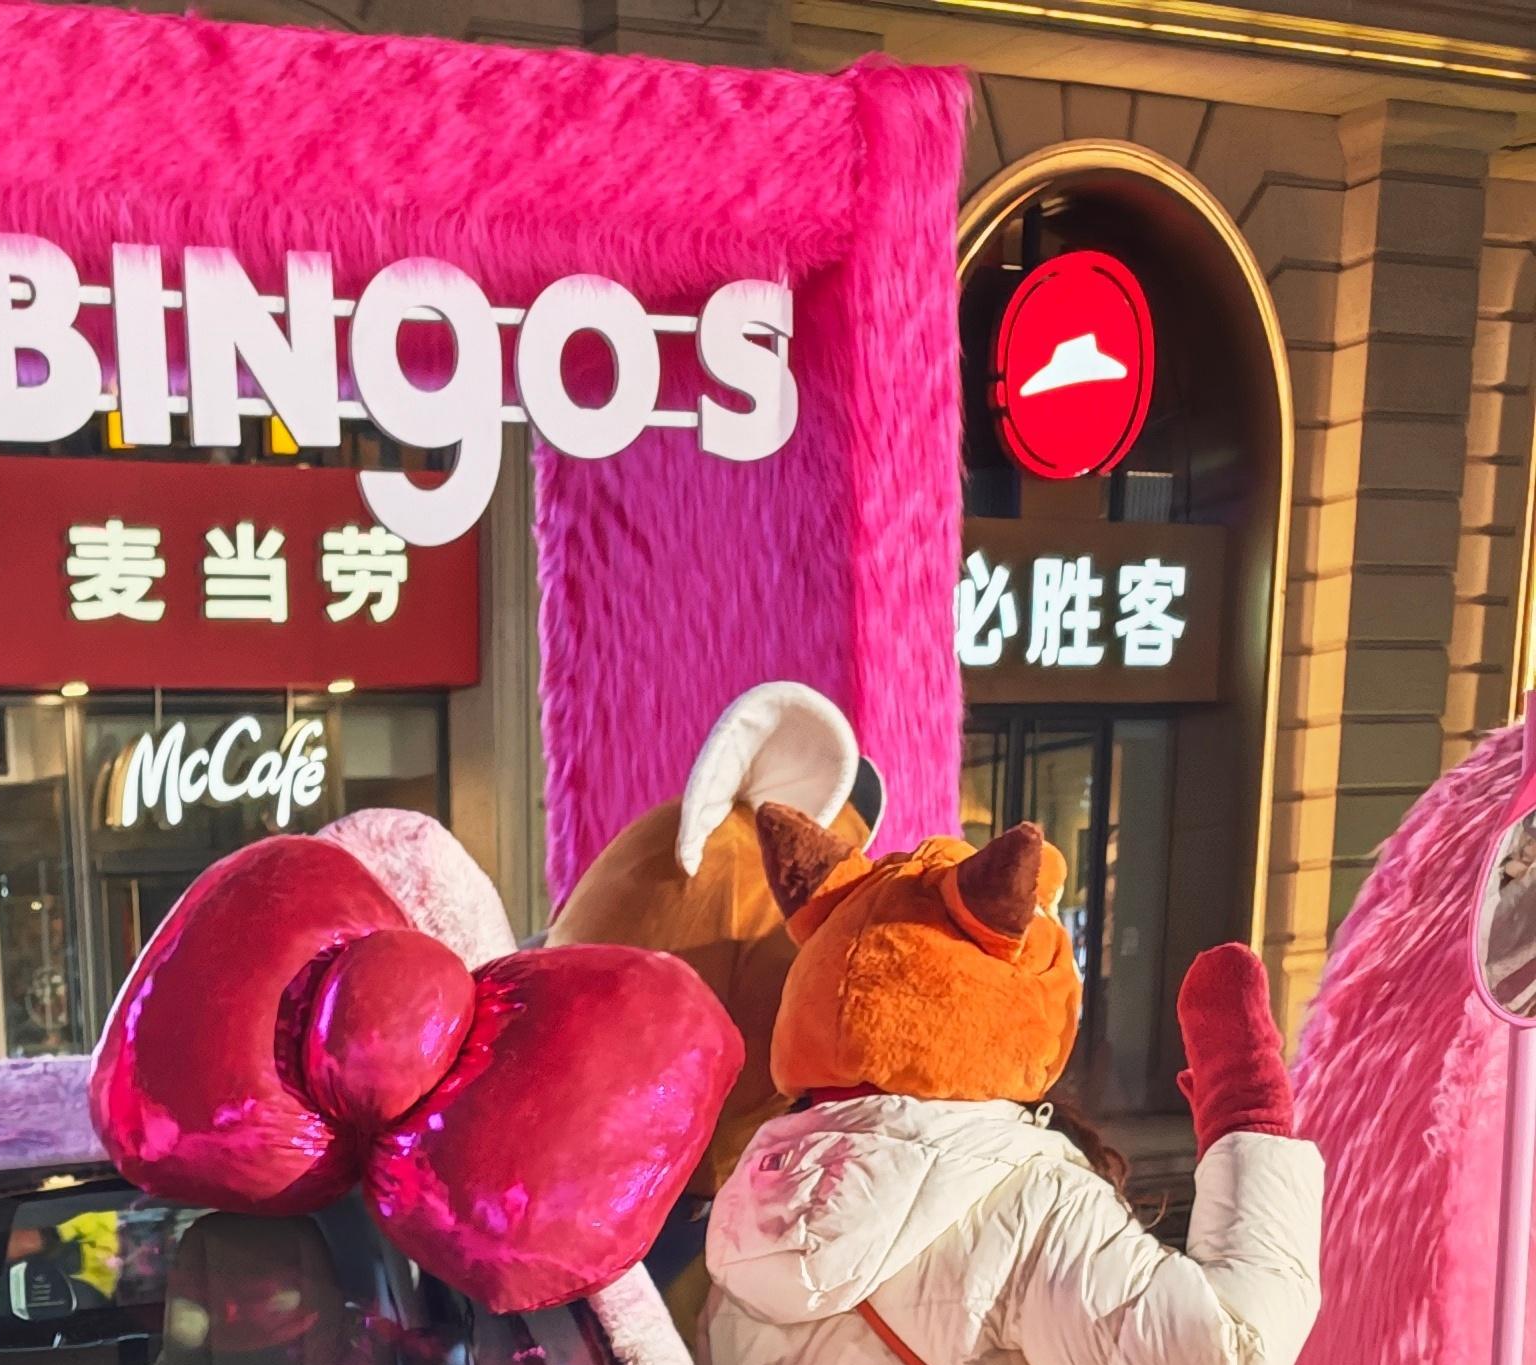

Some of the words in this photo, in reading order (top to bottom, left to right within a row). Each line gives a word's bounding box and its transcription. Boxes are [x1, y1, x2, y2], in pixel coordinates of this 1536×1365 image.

[66, 519, 410, 625] 麦当劳
[953, 549, 1187, 667] 必胜客
[120, 715, 328, 829] McCafé
